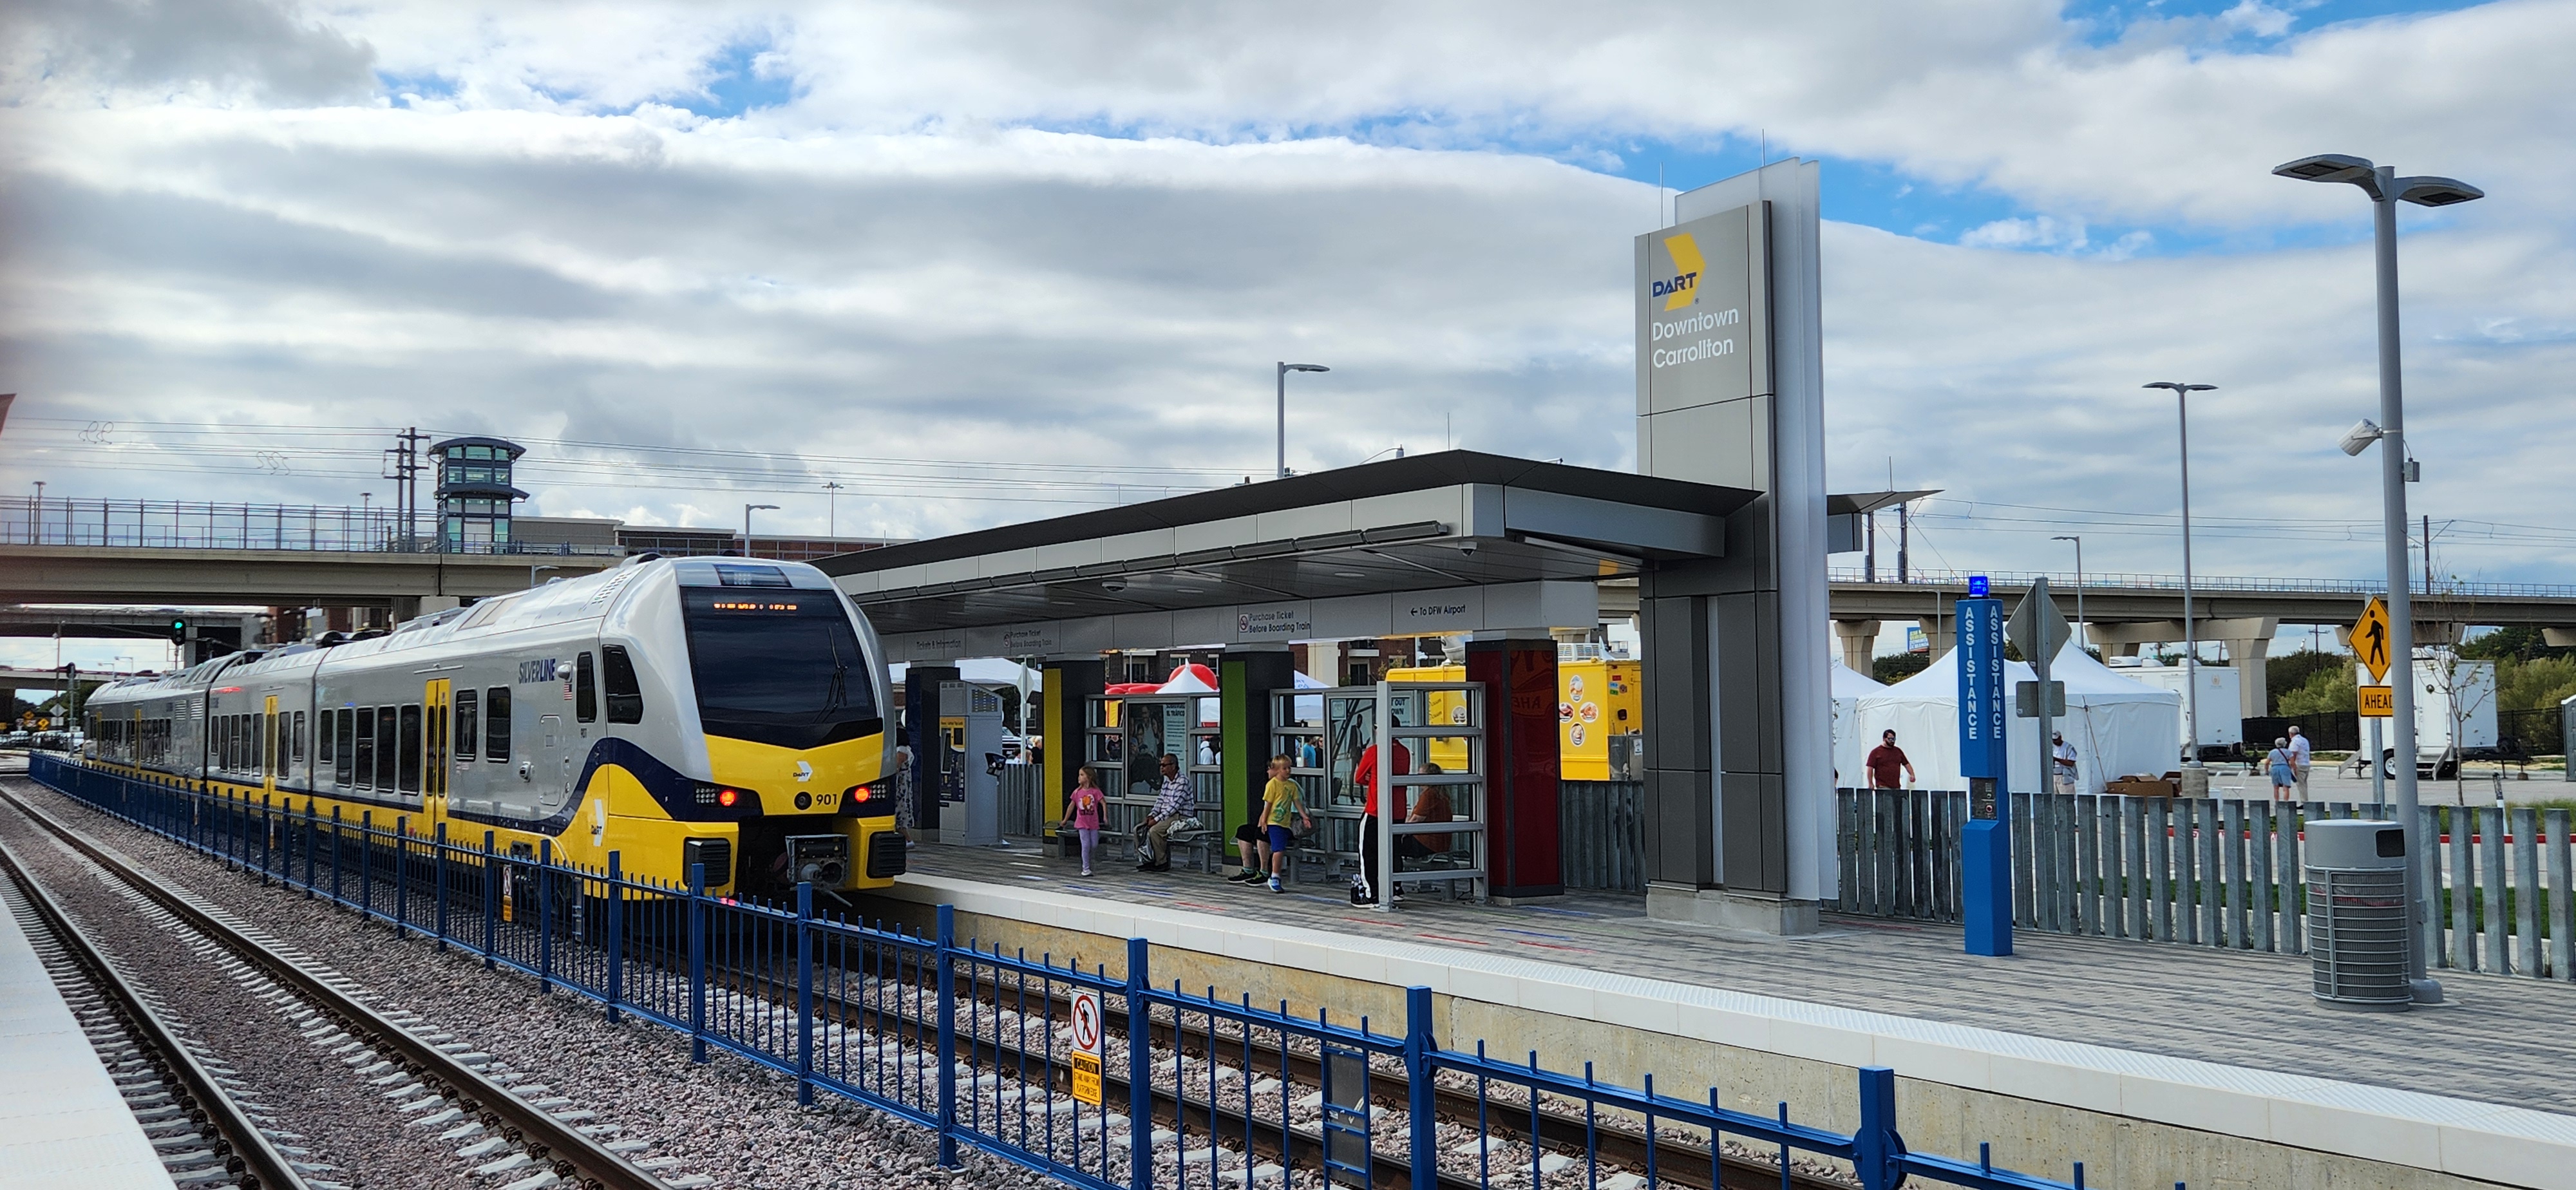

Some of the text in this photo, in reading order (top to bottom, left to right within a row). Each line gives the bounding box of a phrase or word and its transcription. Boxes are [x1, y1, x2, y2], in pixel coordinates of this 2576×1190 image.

[1653, 272, 1697, 298] DART
[1653, 308, 1739, 341] Downtown
[1653, 338, 1734, 368] Carrollton
[1249, 610, 1294, 621] Purchase Ticket
[1419, 604, 1466, 616] To DFW Airport
[1249, 621, 1311, 633] Before Boarding Train
[518, 658, 556, 684] SILVERLINE
[1965, 607, 1978, 740] ASSISTANCE
[1989, 605, 2002, 739] ASSISTANCE
[816, 793, 837, 806] 901
[1076, 1059, 1096, 1073] CAUTION
